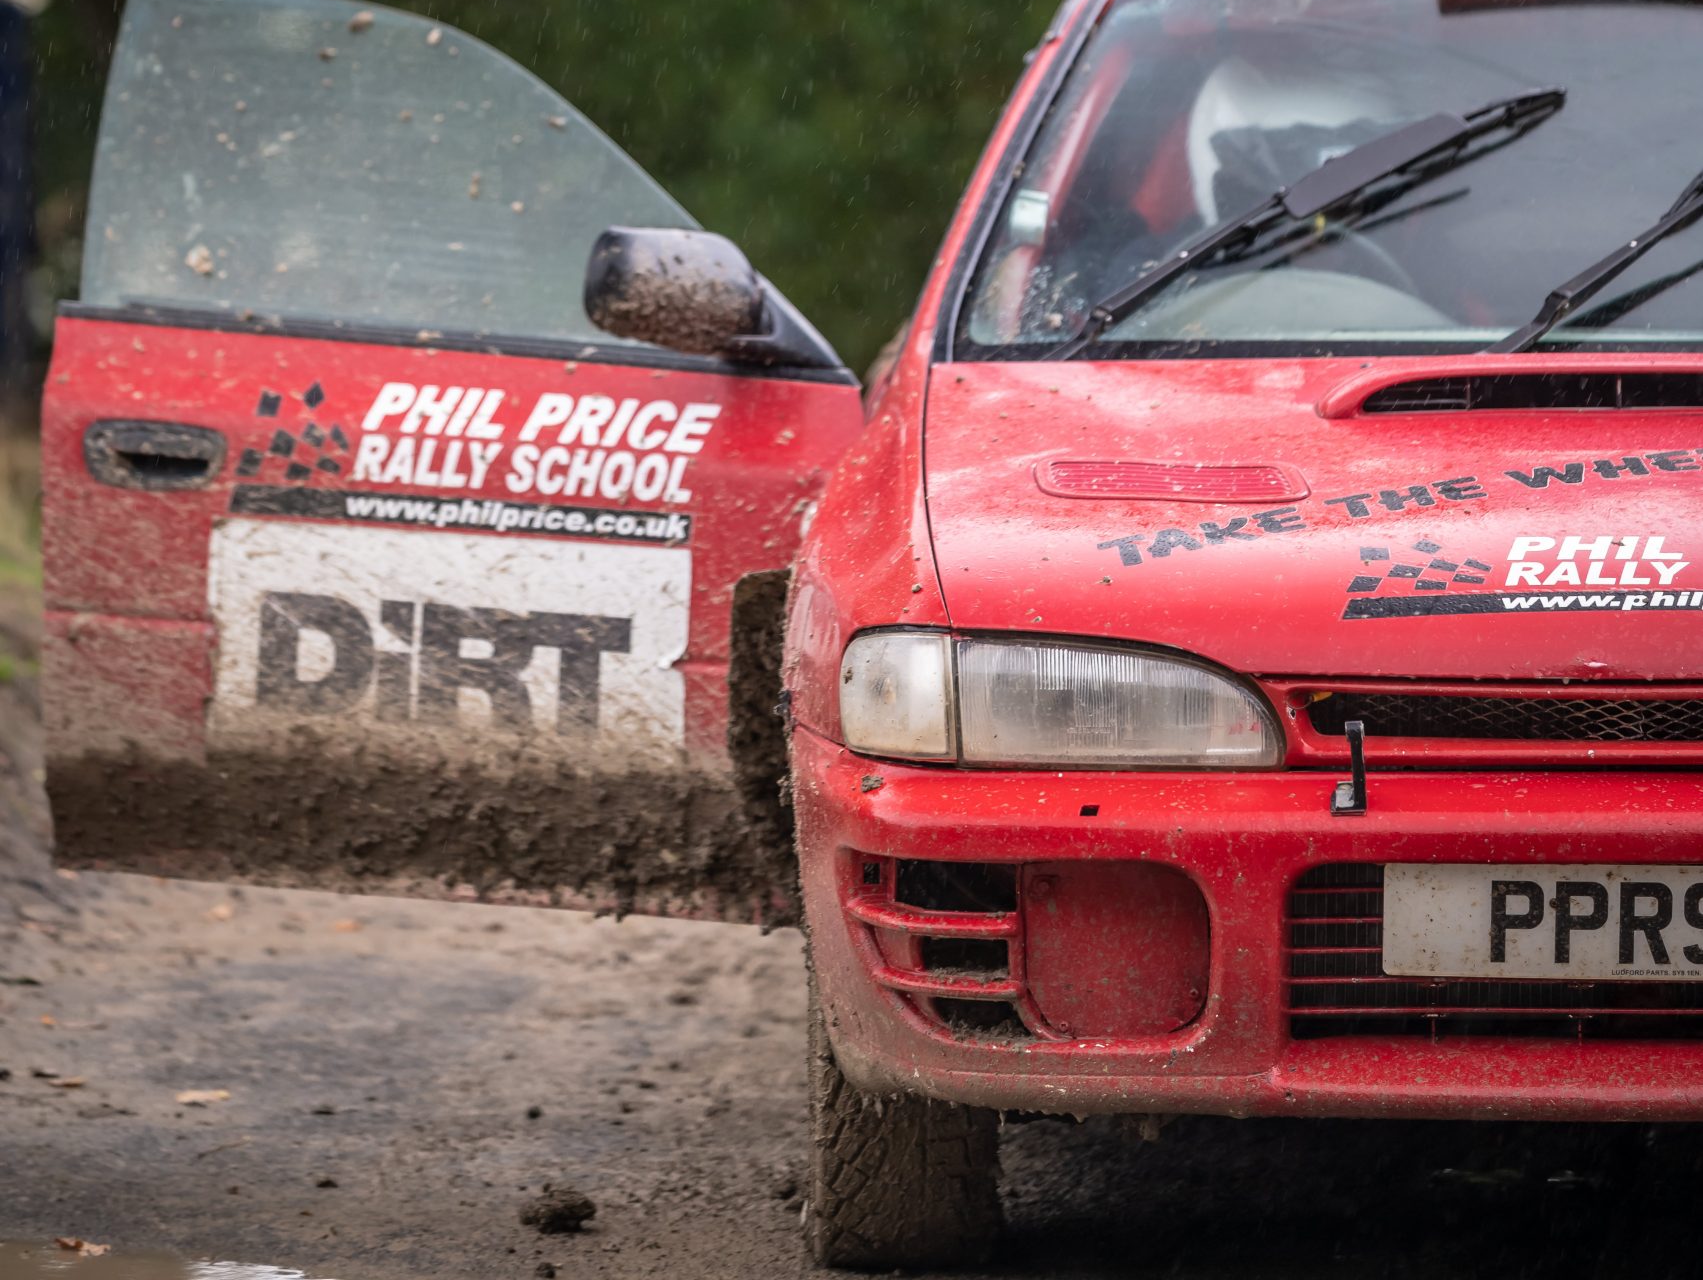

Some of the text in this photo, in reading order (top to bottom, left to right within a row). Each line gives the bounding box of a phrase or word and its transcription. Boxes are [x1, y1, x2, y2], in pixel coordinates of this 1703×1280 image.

[361, 382, 722, 454] PHIL PRICE
[352, 434, 693, 504] RALLY SCHOOL
[345, 495, 689, 540] www.philprice.co.uk
[1097, 448, 1703, 566] TAKE THE WHE
[1506, 535, 1684, 561] PHIL
[1504, 561, 1691, 587] RALLY
[1502, 591, 1703, 611] www.phil
